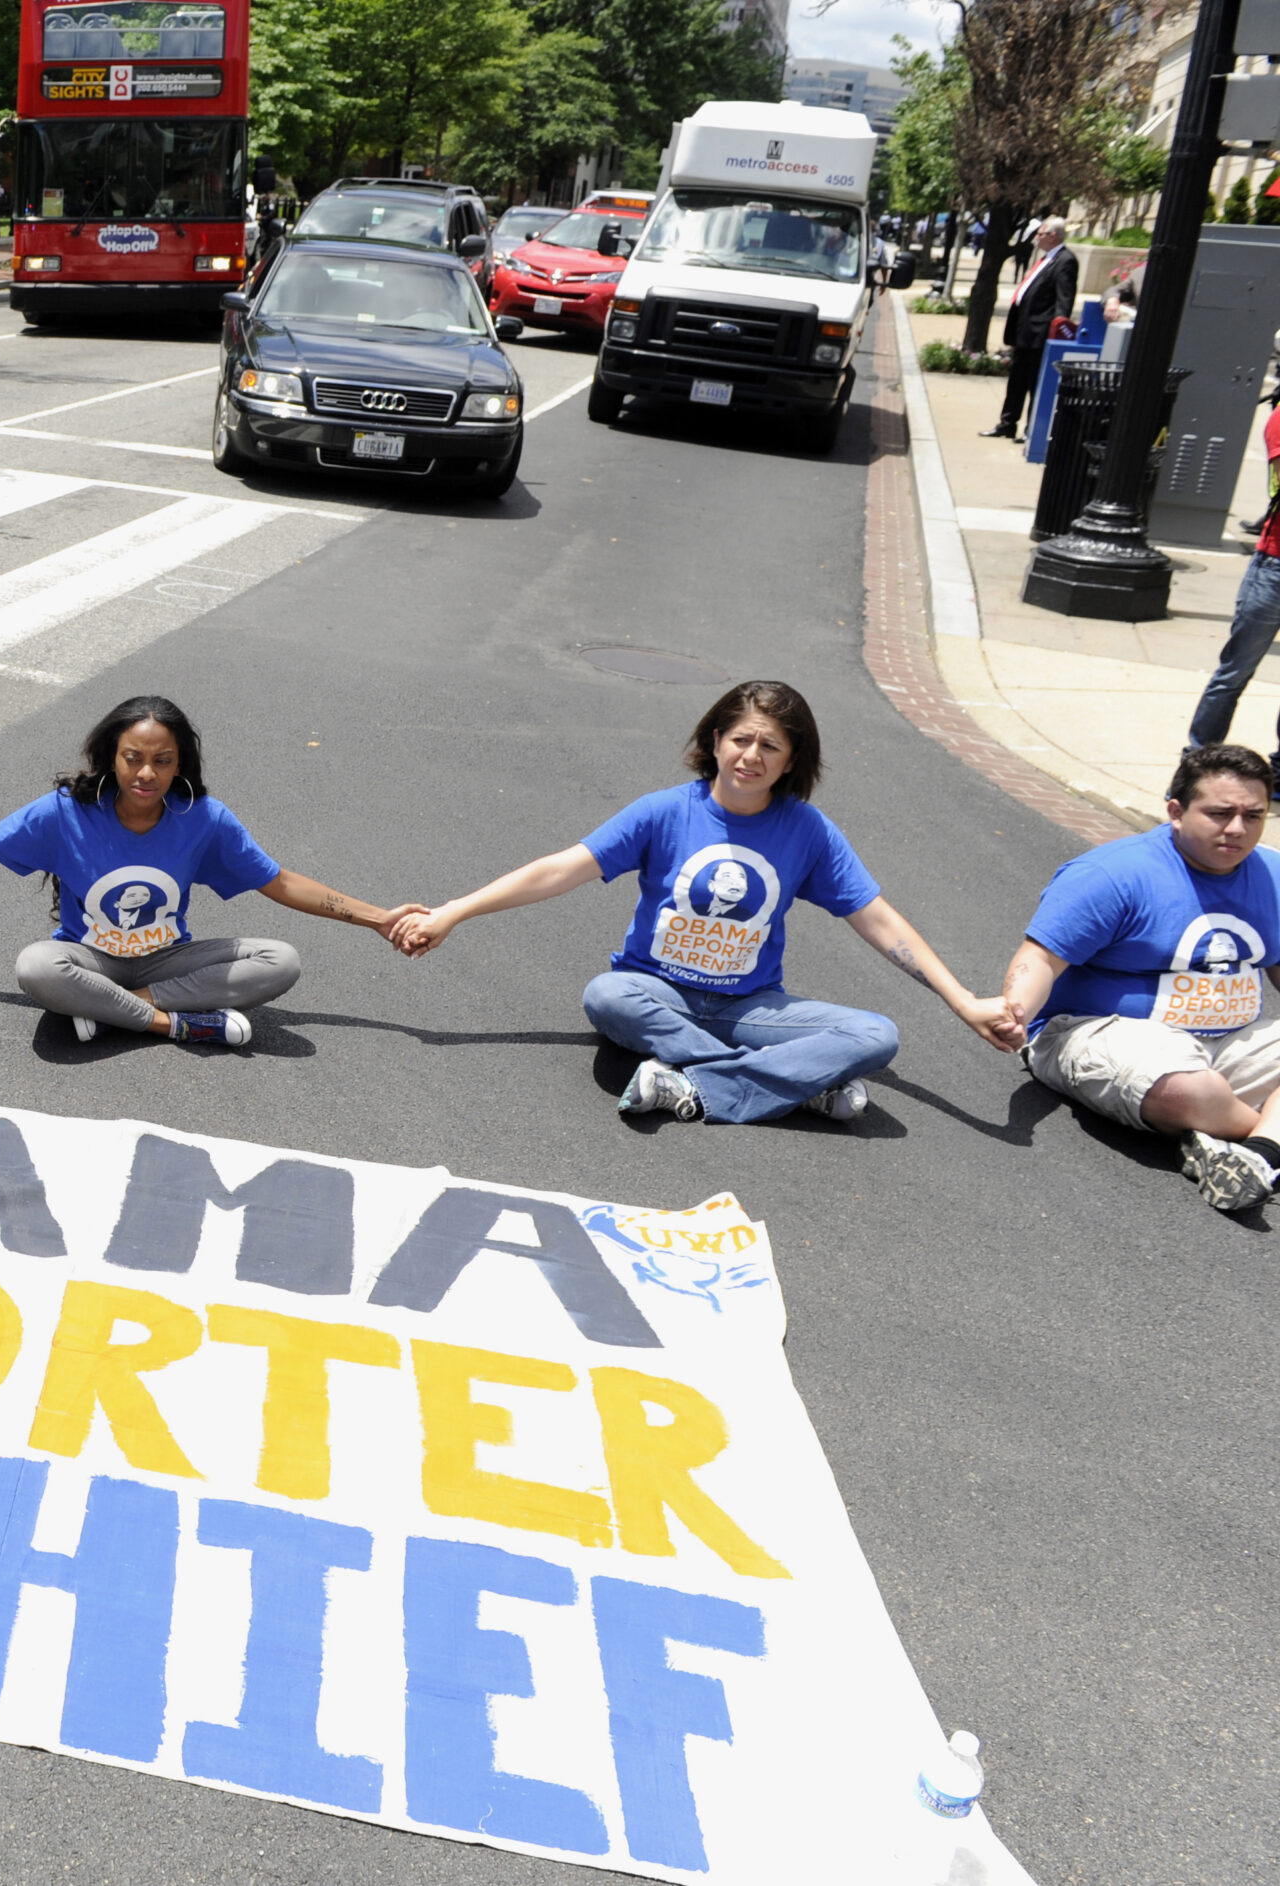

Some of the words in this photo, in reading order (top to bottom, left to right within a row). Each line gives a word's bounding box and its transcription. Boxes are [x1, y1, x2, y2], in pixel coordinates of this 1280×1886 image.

[72, 72, 105, 85] CITY
[114, 69, 128, 96] DC
[49, 86, 104, 98] SIGHTS
[725, 157, 818, 175] metroaccess
[825, 174, 855, 187] 4505
[107, 224, 131, 238] Hop
[132, 224, 150, 236] On
[106, 241, 131, 254] Hop
[669, 915, 761, 945] OBAMA
[664, 932, 755, 958] DEPORTS
[660, 945, 747, 972] PARENTS!
[1173, 975, 1257, 996] OBAMA
[1169, 994, 1257, 1013] DEPORTS
[633, 1224, 757, 1254] UWD
